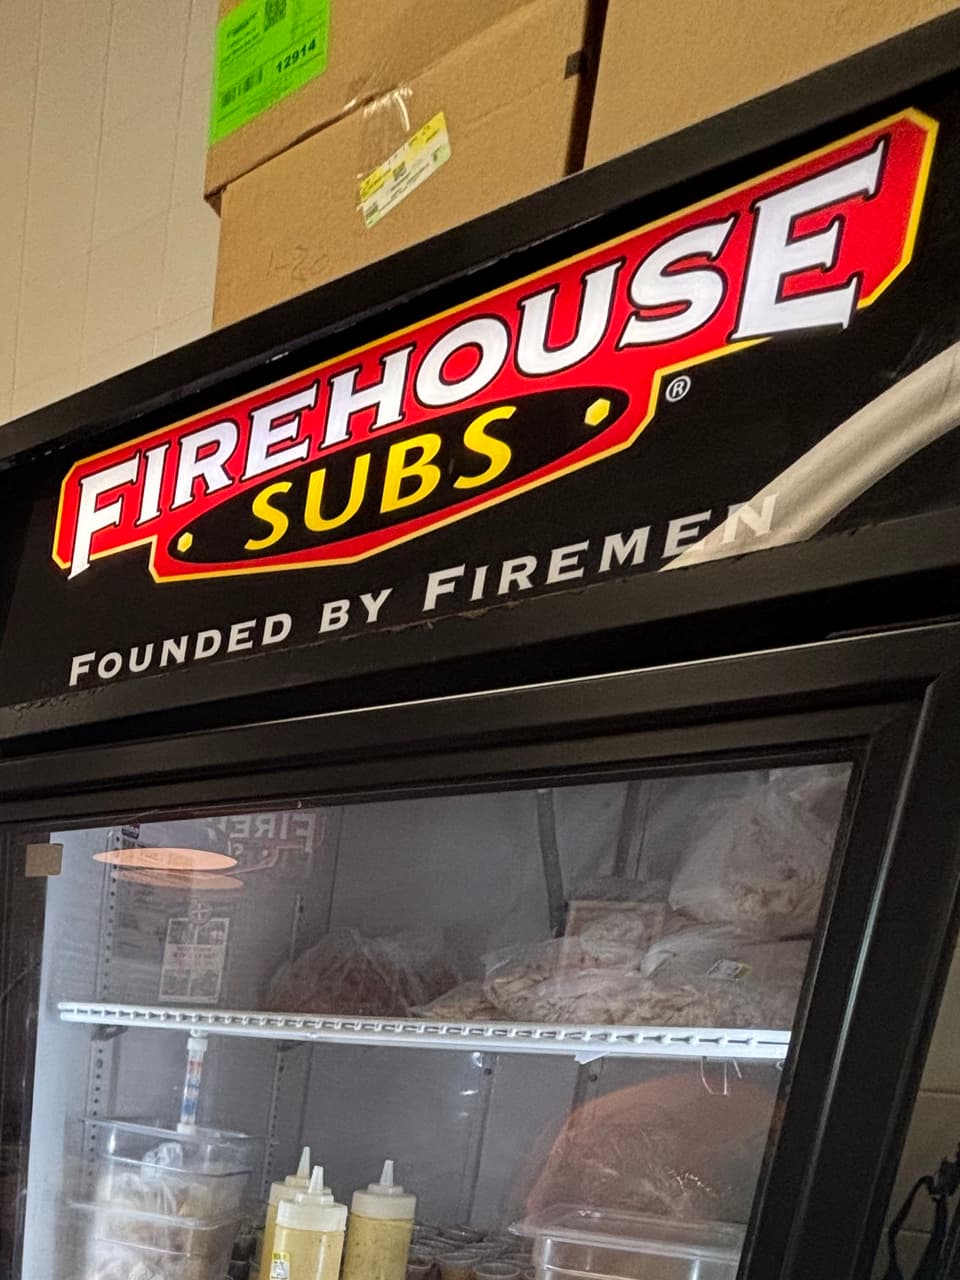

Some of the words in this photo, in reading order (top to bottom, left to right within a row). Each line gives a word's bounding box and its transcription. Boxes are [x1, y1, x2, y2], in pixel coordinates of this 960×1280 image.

[276, 38, 317, 73] 12914
[68, 139, 886, 579] FIREHOUSE
[244, 404, 519, 551] SUBS
[68, 611, 293, 687] FOUNDED
[319, 587, 394, 634] BY
[422, 495, 778, 612] FIREMEN
